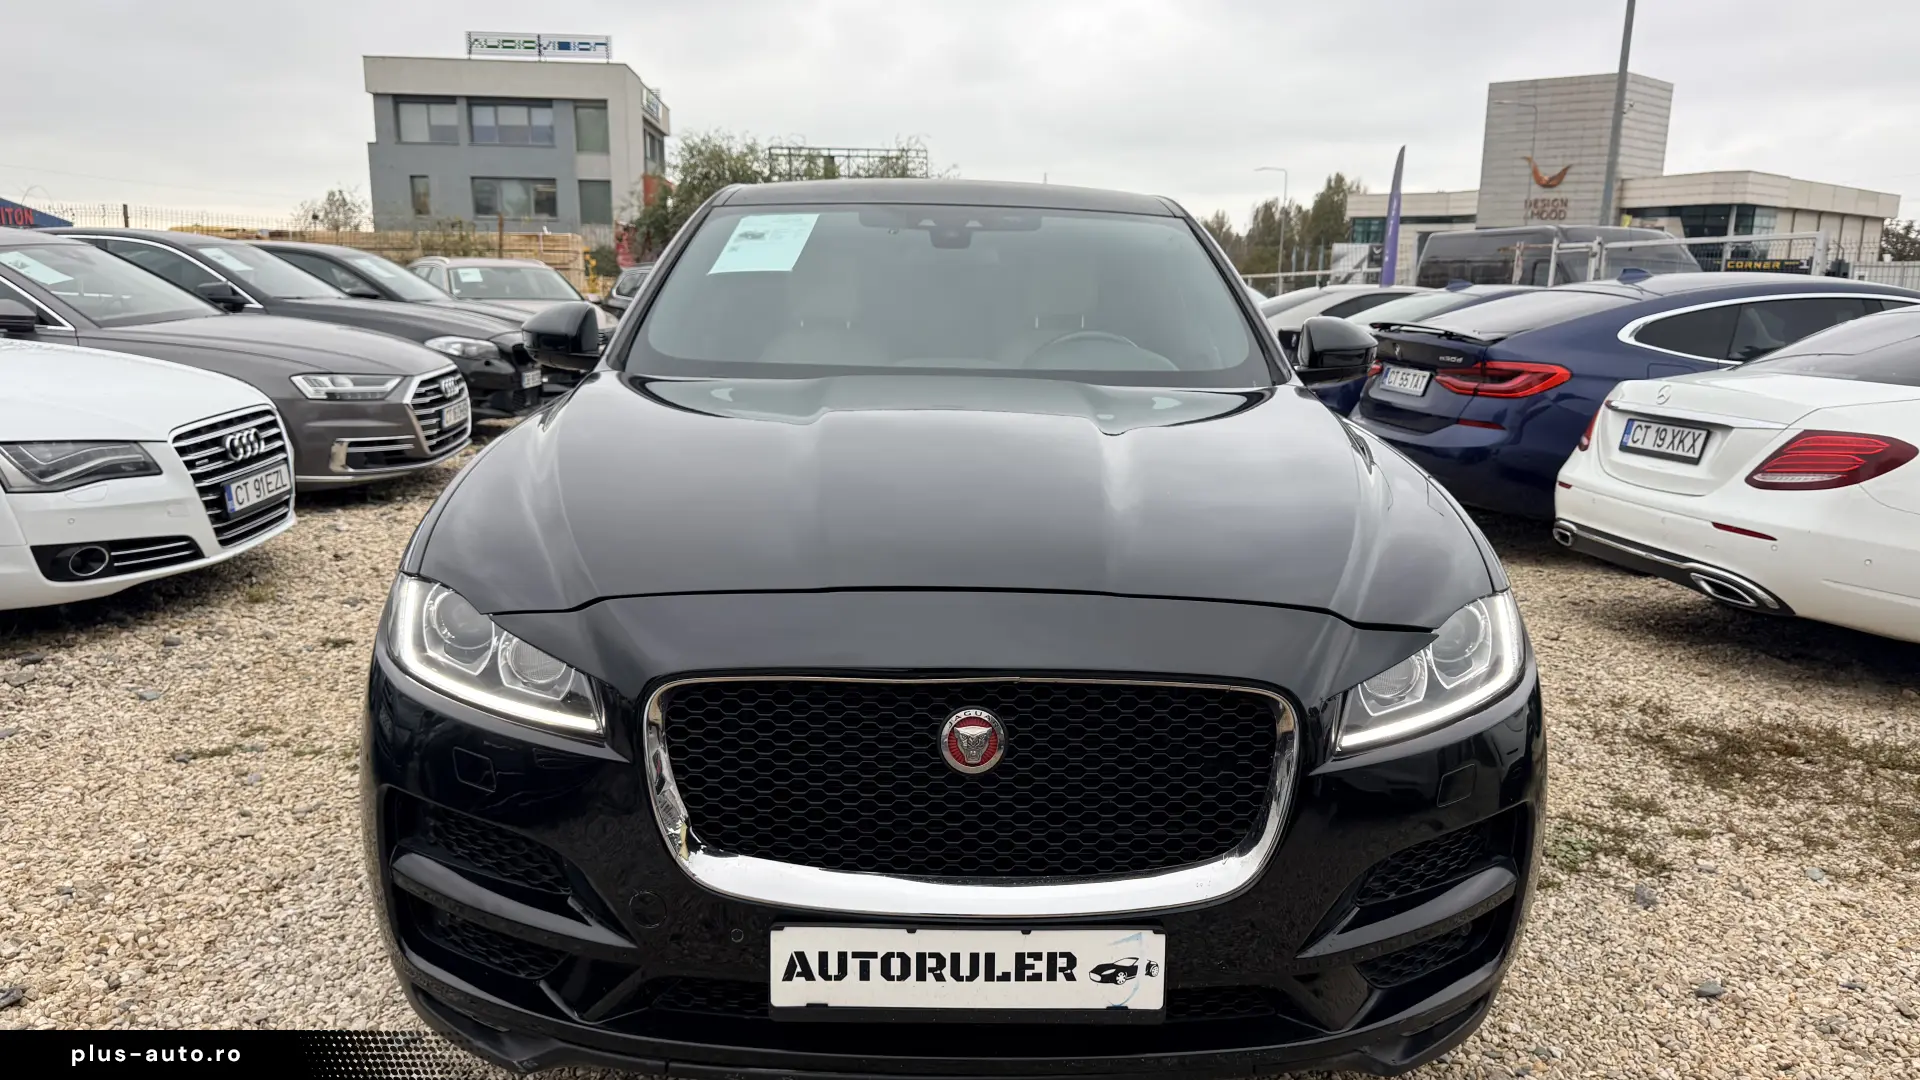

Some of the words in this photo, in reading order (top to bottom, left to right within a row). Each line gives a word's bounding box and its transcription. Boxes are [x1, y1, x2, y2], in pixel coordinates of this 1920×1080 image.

[1727, 261, 1780, 269] CORNER
[1388, 370, 1400, 385] CT
[1631, 424, 1651, 445] CT
[1653, 427, 1668, 448] 19
[1667, 429, 1702, 454] XKX
[235, 482, 250, 505] CT
[948, 710, 999, 729] JAGUAR
[782, 950, 1078, 982] AUTORULER
